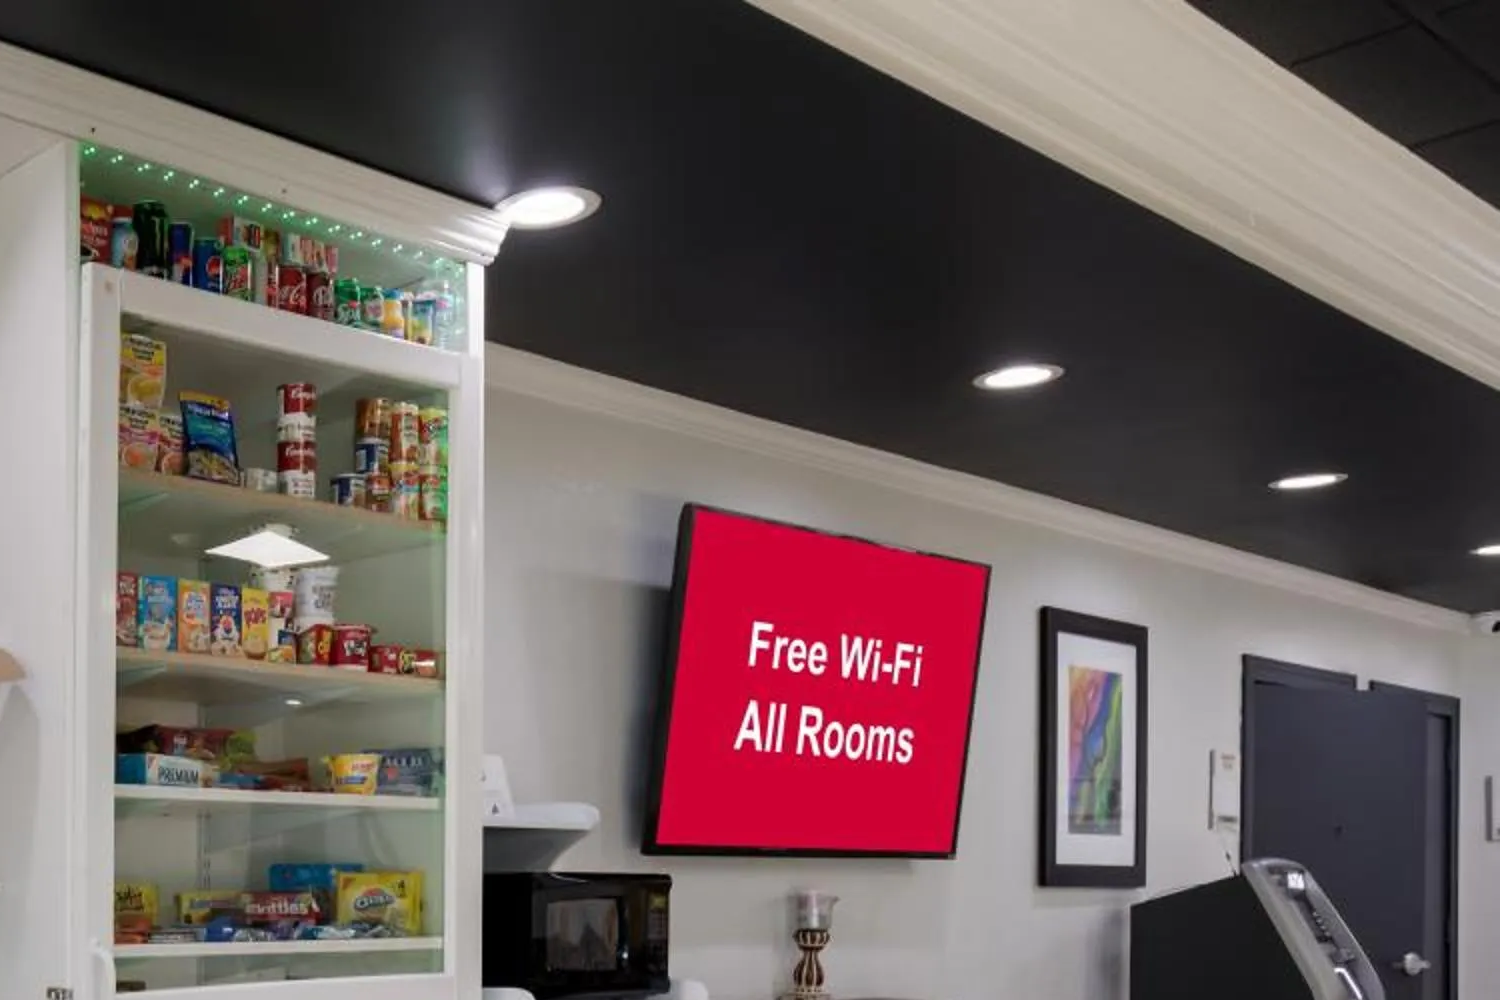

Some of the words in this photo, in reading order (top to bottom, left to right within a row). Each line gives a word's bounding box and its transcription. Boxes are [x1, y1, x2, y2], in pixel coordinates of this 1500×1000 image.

[748, 621, 828, 676] Free
[840, 633, 924, 688] Wi-Fi
[733, 700, 787, 753] All
[796, 705, 915, 765] Rooms
